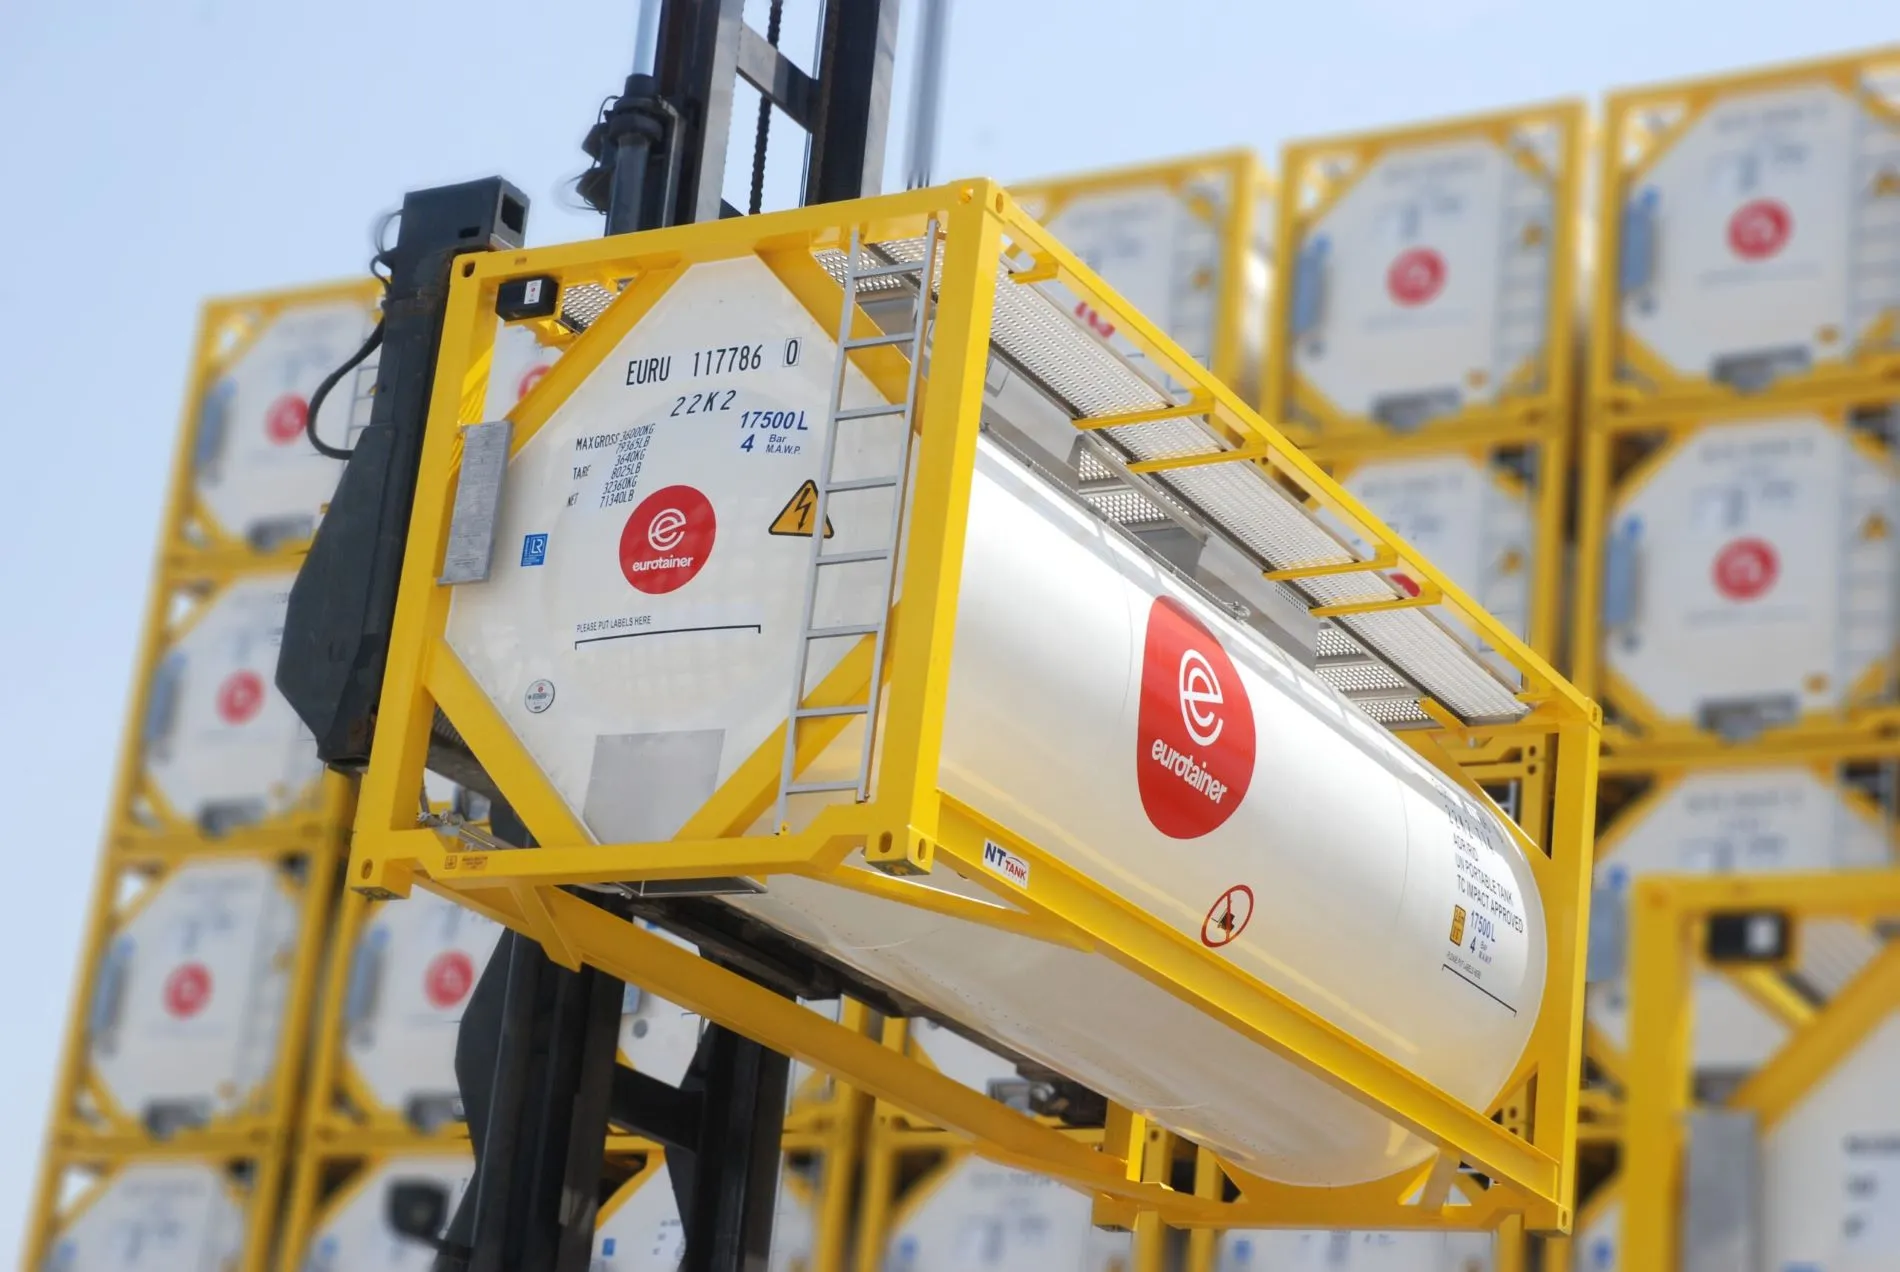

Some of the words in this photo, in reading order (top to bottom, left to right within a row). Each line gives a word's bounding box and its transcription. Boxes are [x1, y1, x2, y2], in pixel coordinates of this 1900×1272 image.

[626, 356, 671, 386] EURU
[694, 344, 763, 377] 117786
[670, 390, 737, 417] 22K2
[741, 434, 755, 452] 4
[769, 434, 787, 443] Bar
[632, 555, 694, 572] eurotainer
[576, 622, 597, 632] PLEASE
[598, 619, 609, 630] PUT
[611, 617, 633, 628] LABELS
[634, 615, 652, 625] HERE
[1152, 739, 1227, 803] eurotainer
[985, 842, 1007, 867] NT
[1005, 860, 1027, 880] TANK
[1470, 936, 1476, 953] 4
